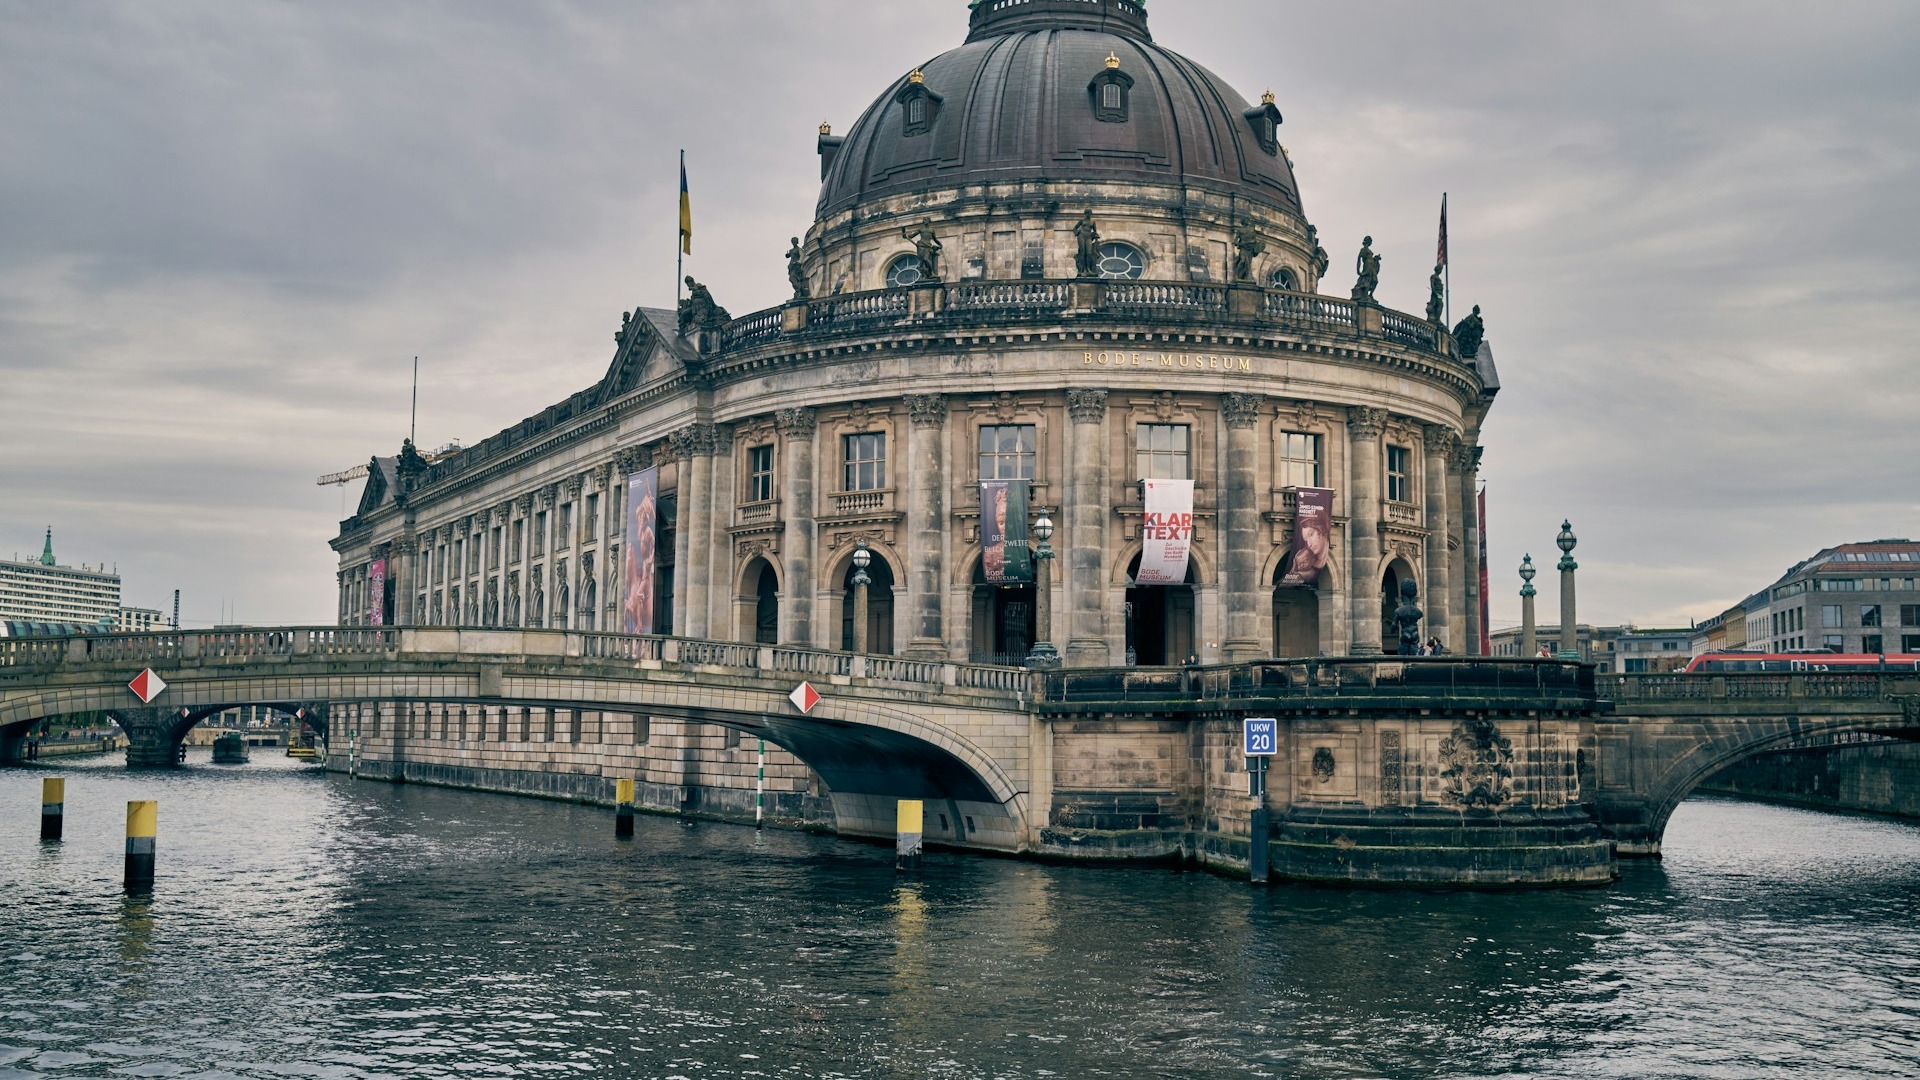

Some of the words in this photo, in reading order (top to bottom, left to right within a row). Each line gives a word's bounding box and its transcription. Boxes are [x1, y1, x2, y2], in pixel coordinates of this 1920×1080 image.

[1084, 352, 1250, 370] BODE-MUSEUM
[1144, 512, 1192, 526] KLAR
[1144, 526, 1192, 540] TEXT
[1760, 660, 1766, 671] 1
[1250, 723, 1270, 732] UKW
[1251, 734, 1270, 750] 20
